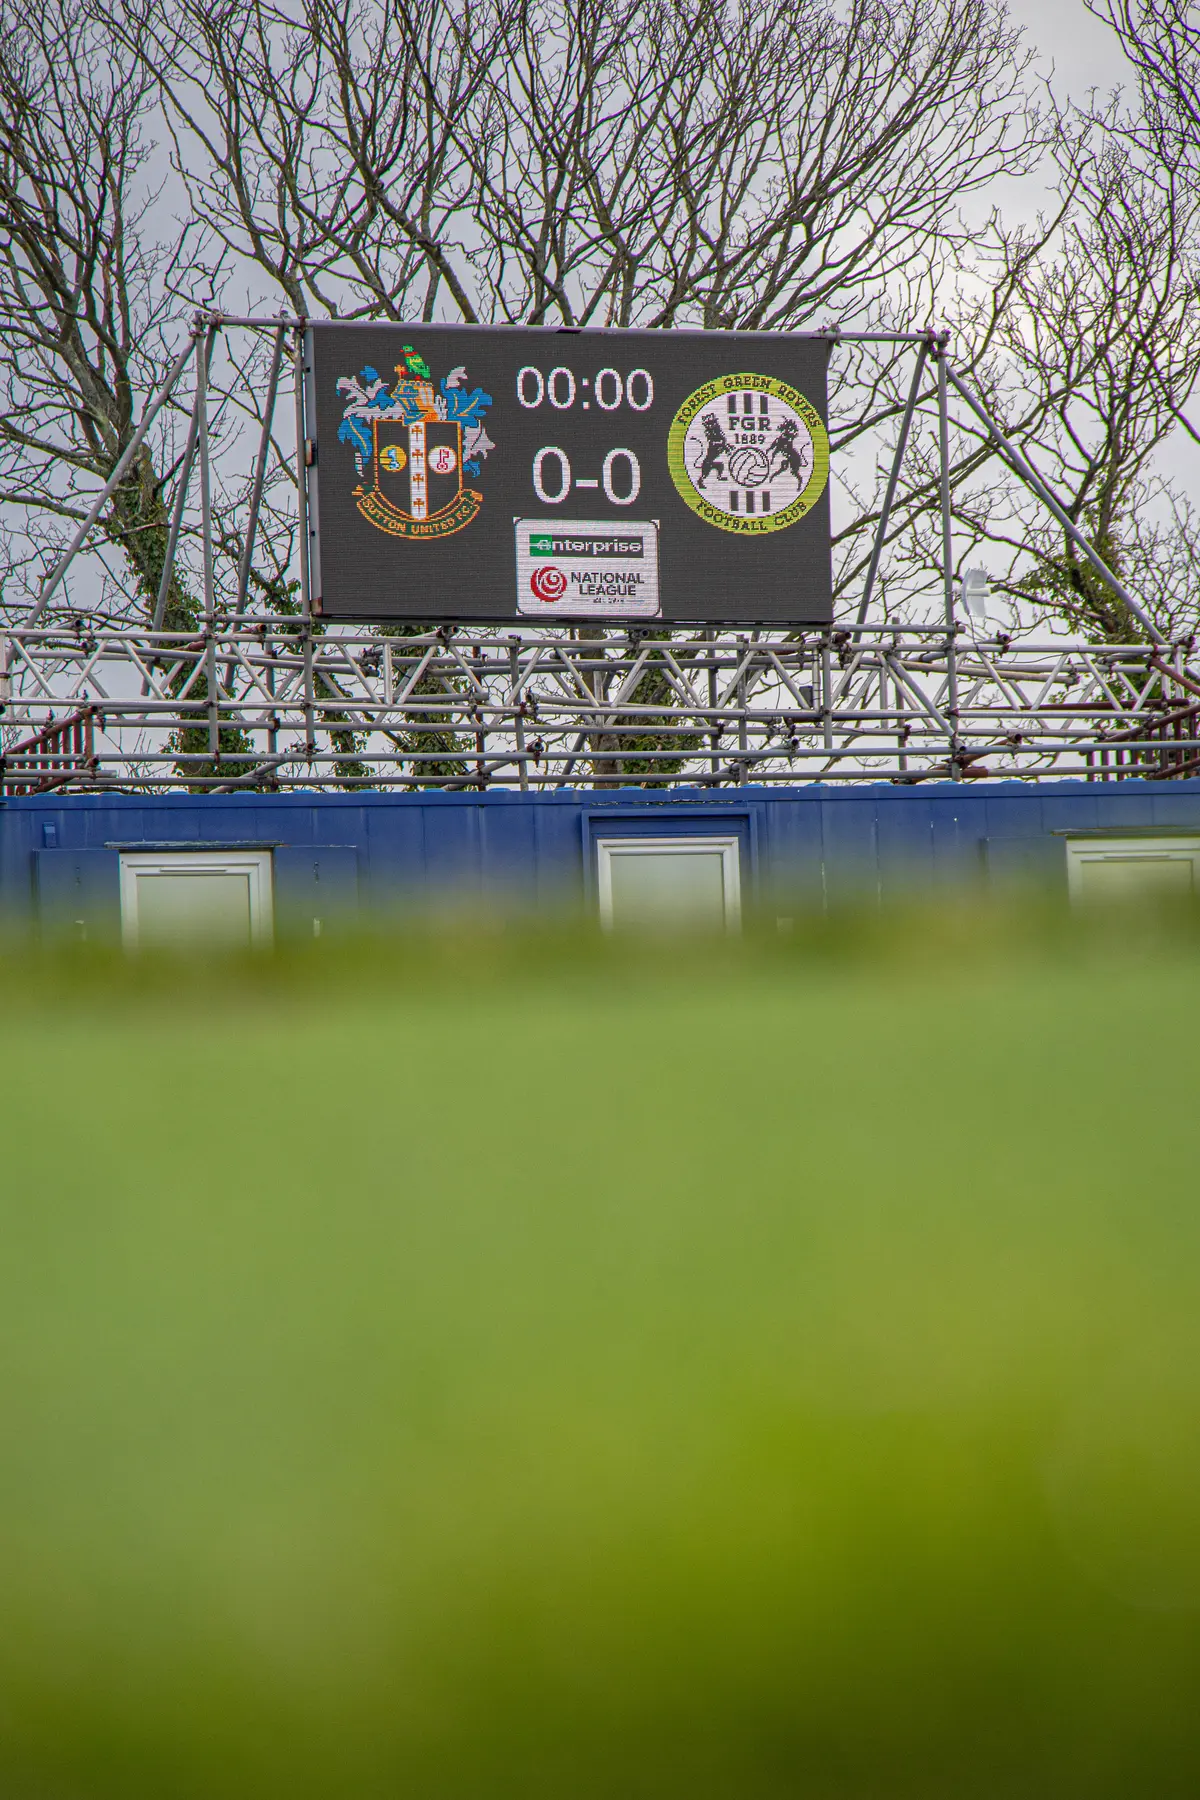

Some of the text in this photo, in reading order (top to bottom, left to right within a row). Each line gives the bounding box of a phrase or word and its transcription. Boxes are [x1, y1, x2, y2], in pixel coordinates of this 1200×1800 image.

[517, 366, 654, 411] 00:00
[728, 416, 771, 431] FGR
[735, 433, 765, 444] 1889
[533, 446, 641, 505] 0-0
[362, 498, 406, 533] SUTTON
[411, 518, 456, 534] UNITED
[696, 501, 807, 530] FOOTBALL CLUB
[537, 539, 643, 555] enterprise
[571, 572, 645, 584] NATIONAL
[579, 584, 637, 596] LEAGUE
